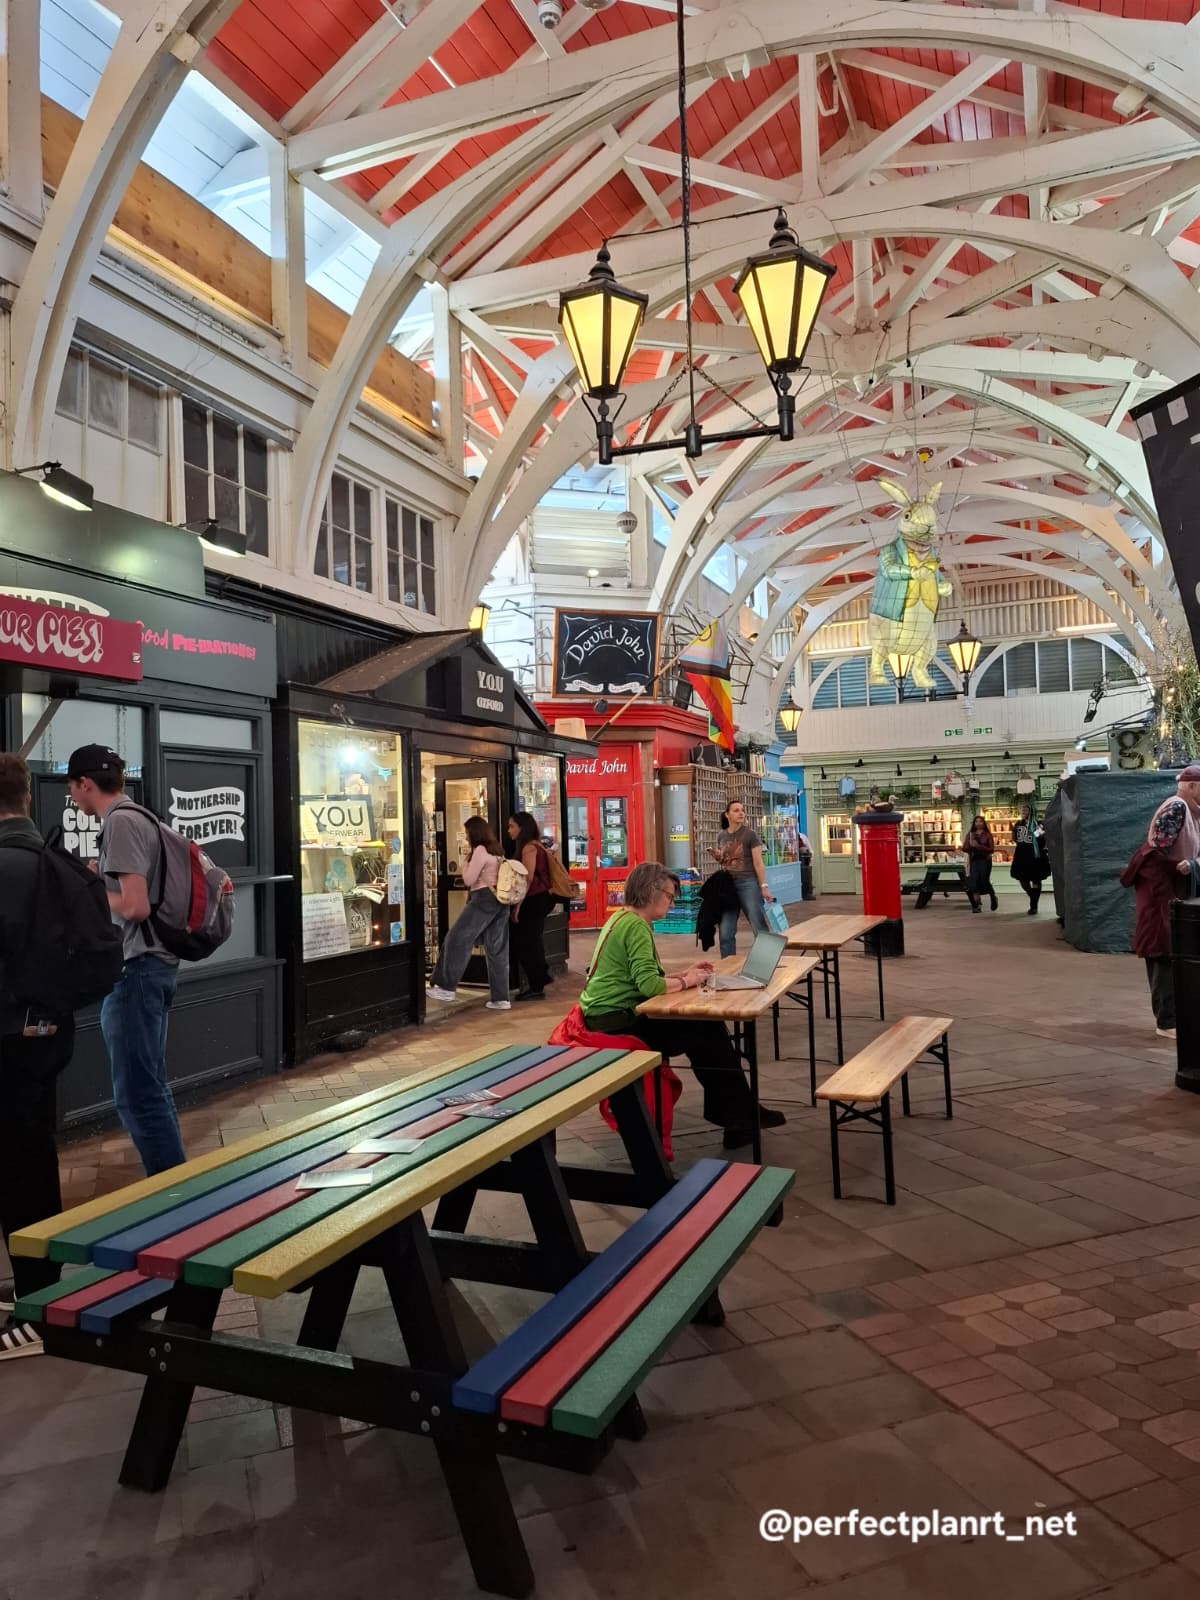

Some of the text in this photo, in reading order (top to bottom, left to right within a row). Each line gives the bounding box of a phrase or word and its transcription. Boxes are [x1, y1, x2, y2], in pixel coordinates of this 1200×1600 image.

[0, 610, 104, 664] UR PIES!
[566, 624, 646, 665] David John
[598, 758, 627, 776] John
[177, 792, 241, 811] MOTHERSHIP
[62, 808, 104, 831] COL
[178, 819, 237, 840] FOREVER!
